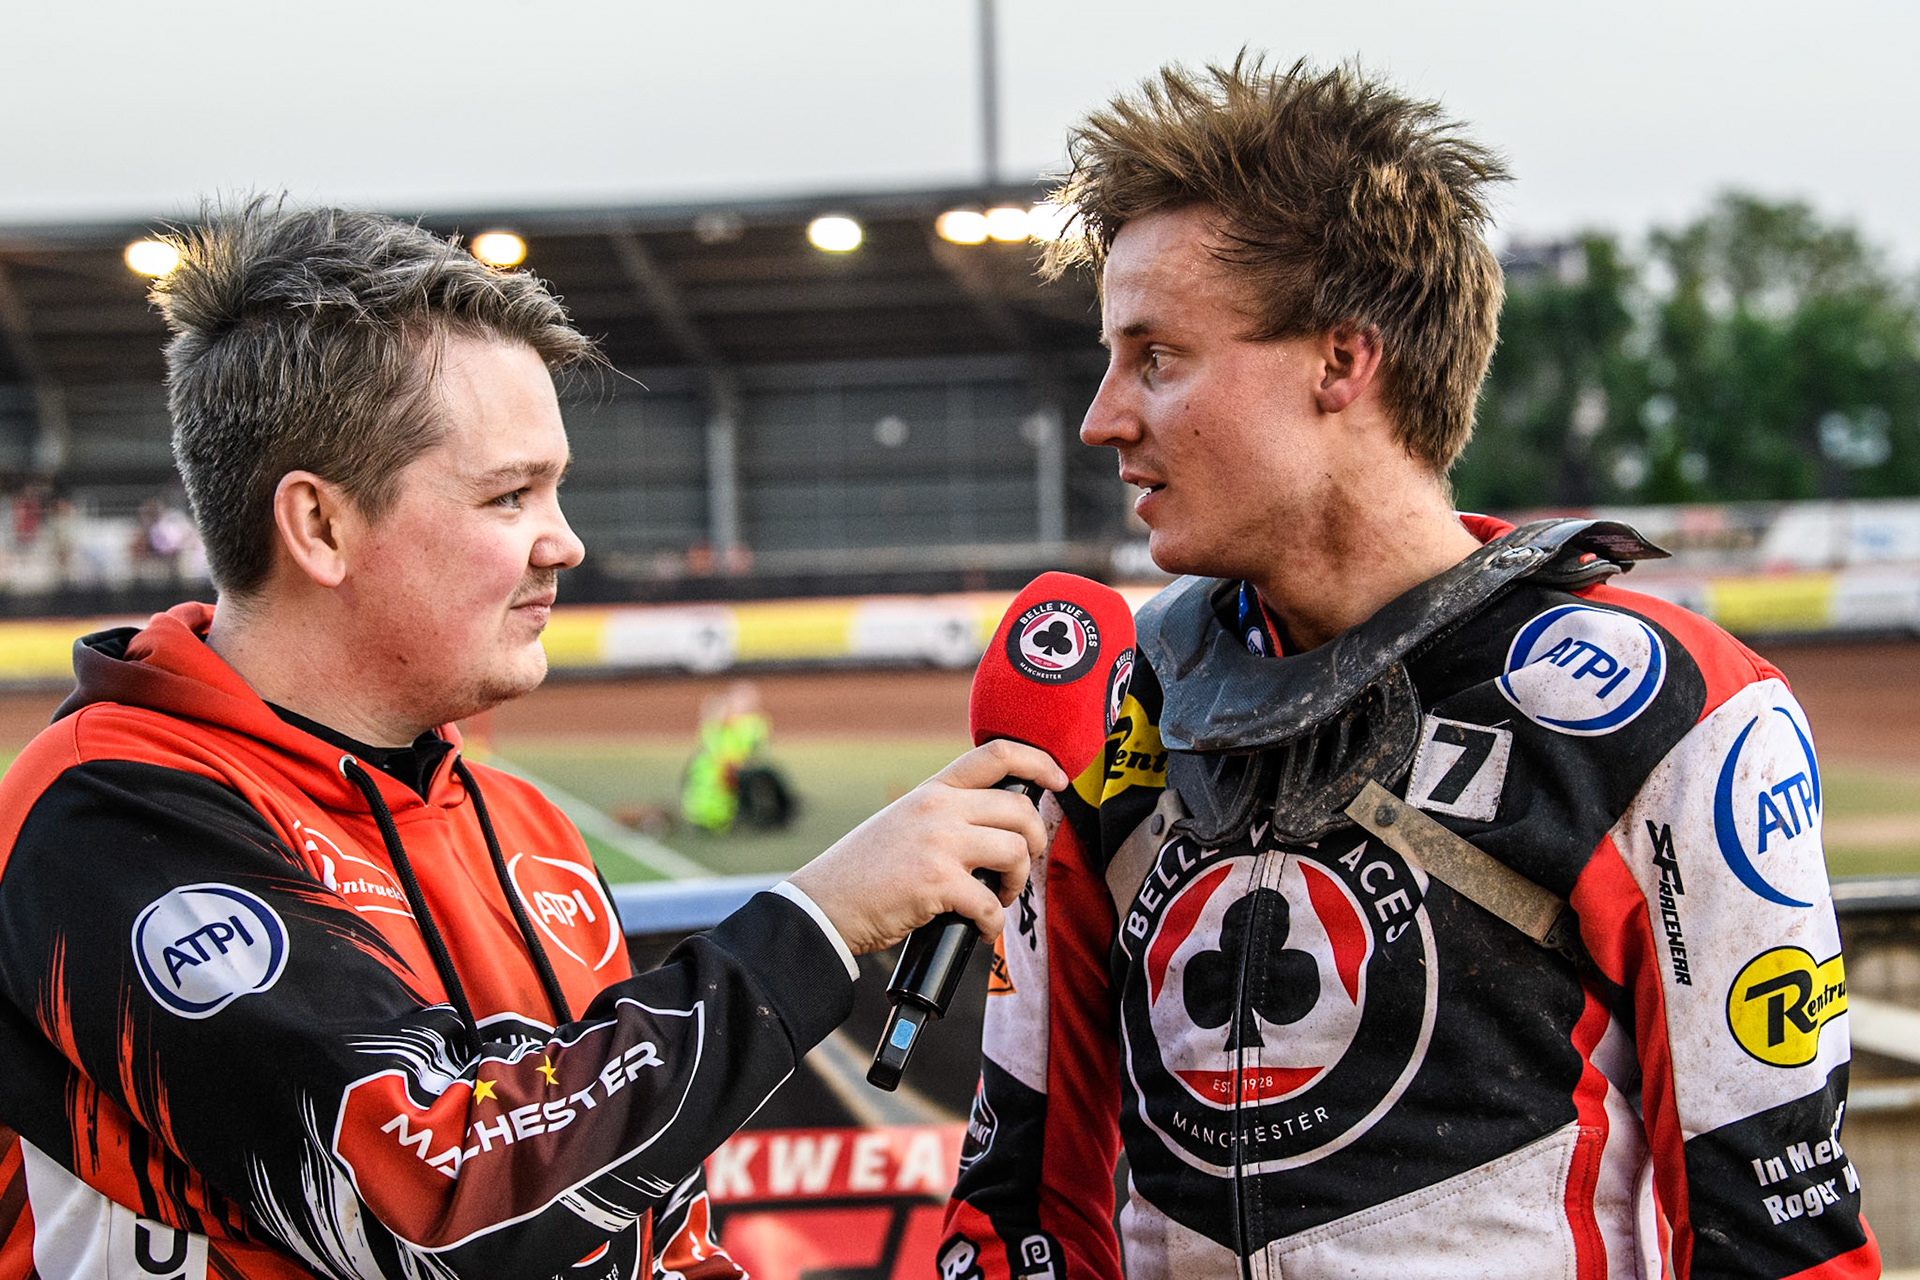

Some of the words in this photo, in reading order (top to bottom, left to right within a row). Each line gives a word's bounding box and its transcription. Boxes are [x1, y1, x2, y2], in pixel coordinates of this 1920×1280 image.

[1020, 603, 1054, 625] BELLE
[1060, 603, 1084, 618] VUE
[1081, 619, 1098, 648] ACES
[1020, 662, 1062, 680] MANCHESTER
[1532, 637, 1631, 700] ATPI
[1430, 723, 1496, 805] 7
[533, 889, 596, 928] ATPI
[1126, 845, 1221, 940] BELL
[162, 915, 255, 990] ATPI
[1658, 880, 1693, 987] RACEWEAR
[1242, 1075, 1274, 1091] 1928
[380, 1040, 665, 1180] MAHESTER
[1172, 1106, 1330, 1149] MANCHESTER
[1751, 1157, 1789, 1187] In
[1762, 1177, 1841, 1226] Roger
